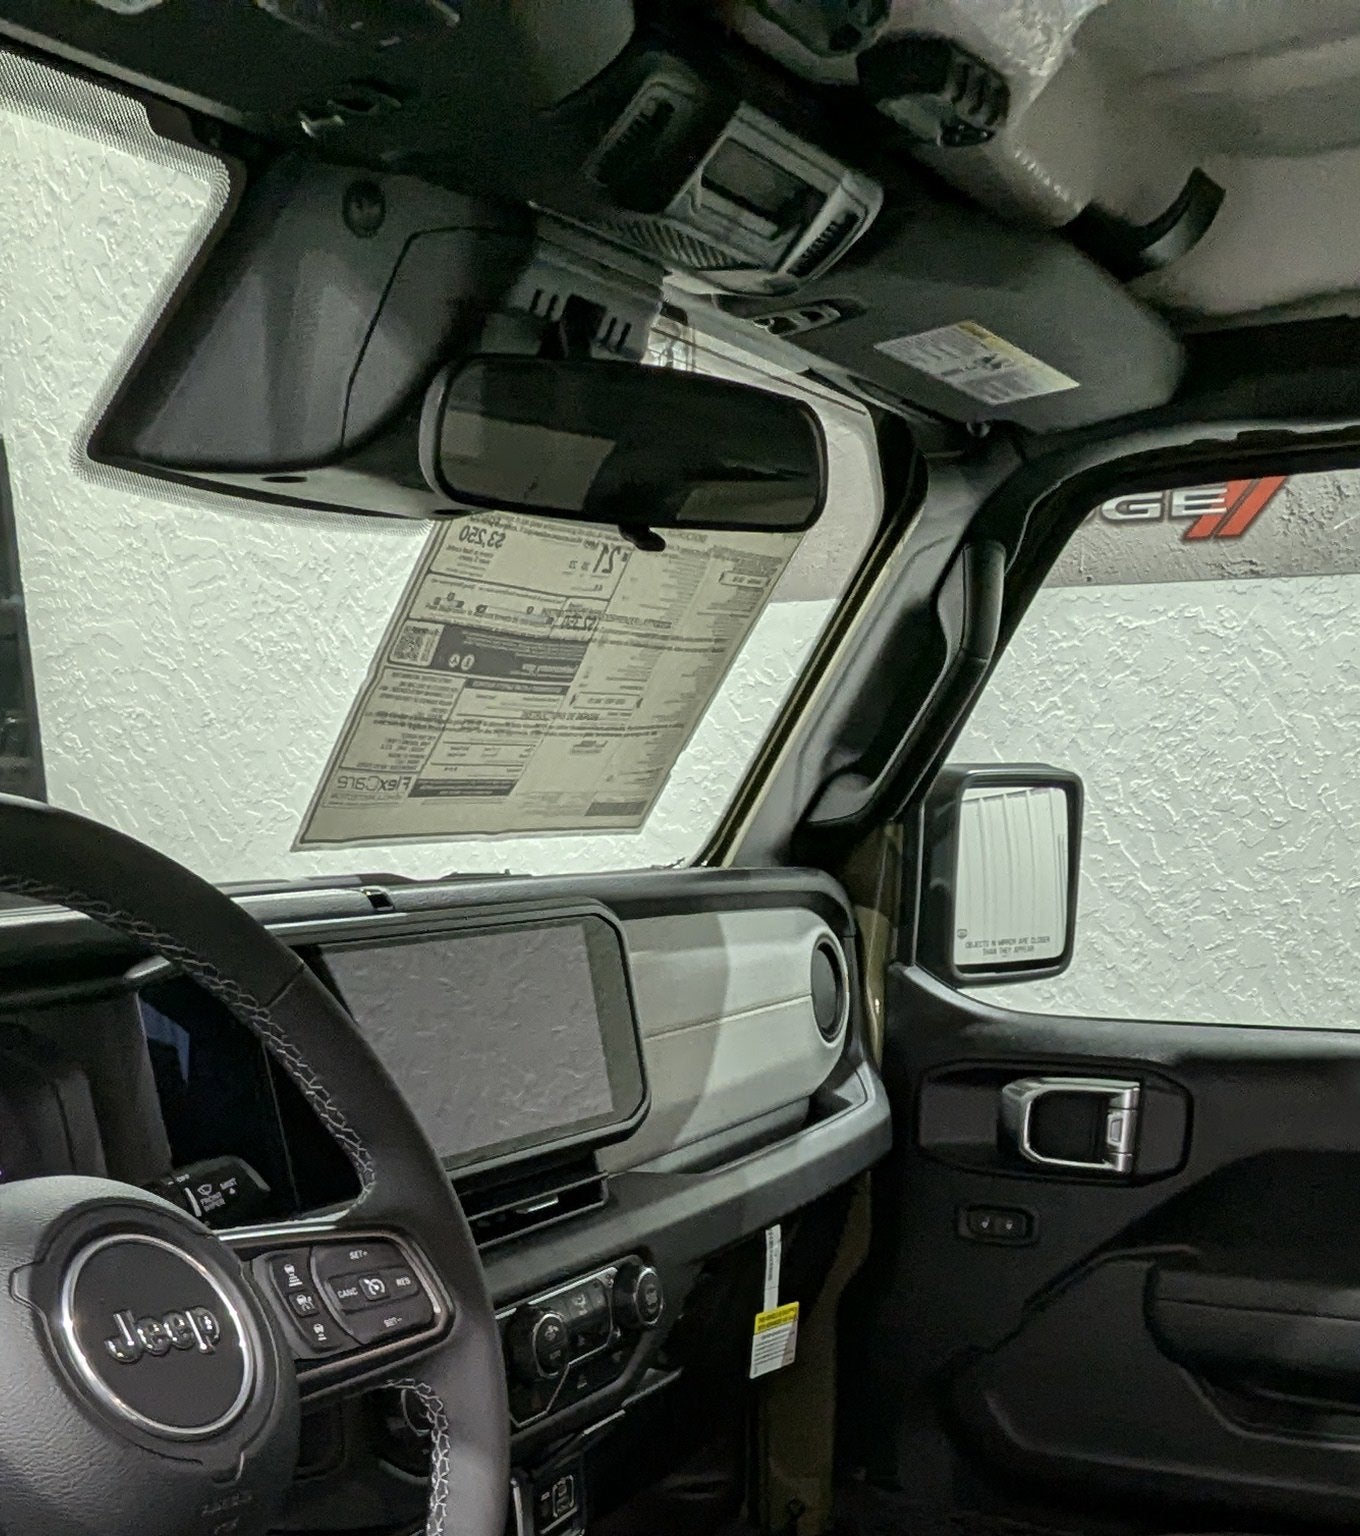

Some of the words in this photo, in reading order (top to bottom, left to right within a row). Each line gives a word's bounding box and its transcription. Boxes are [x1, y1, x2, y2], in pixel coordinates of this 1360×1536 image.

[349, 1249, 368, 1260] SET+
[395, 1276, 411, 1286] RES
[337, 1287, 359, 1299] CANC
[103, 1304, 222, 1364] Jeep
